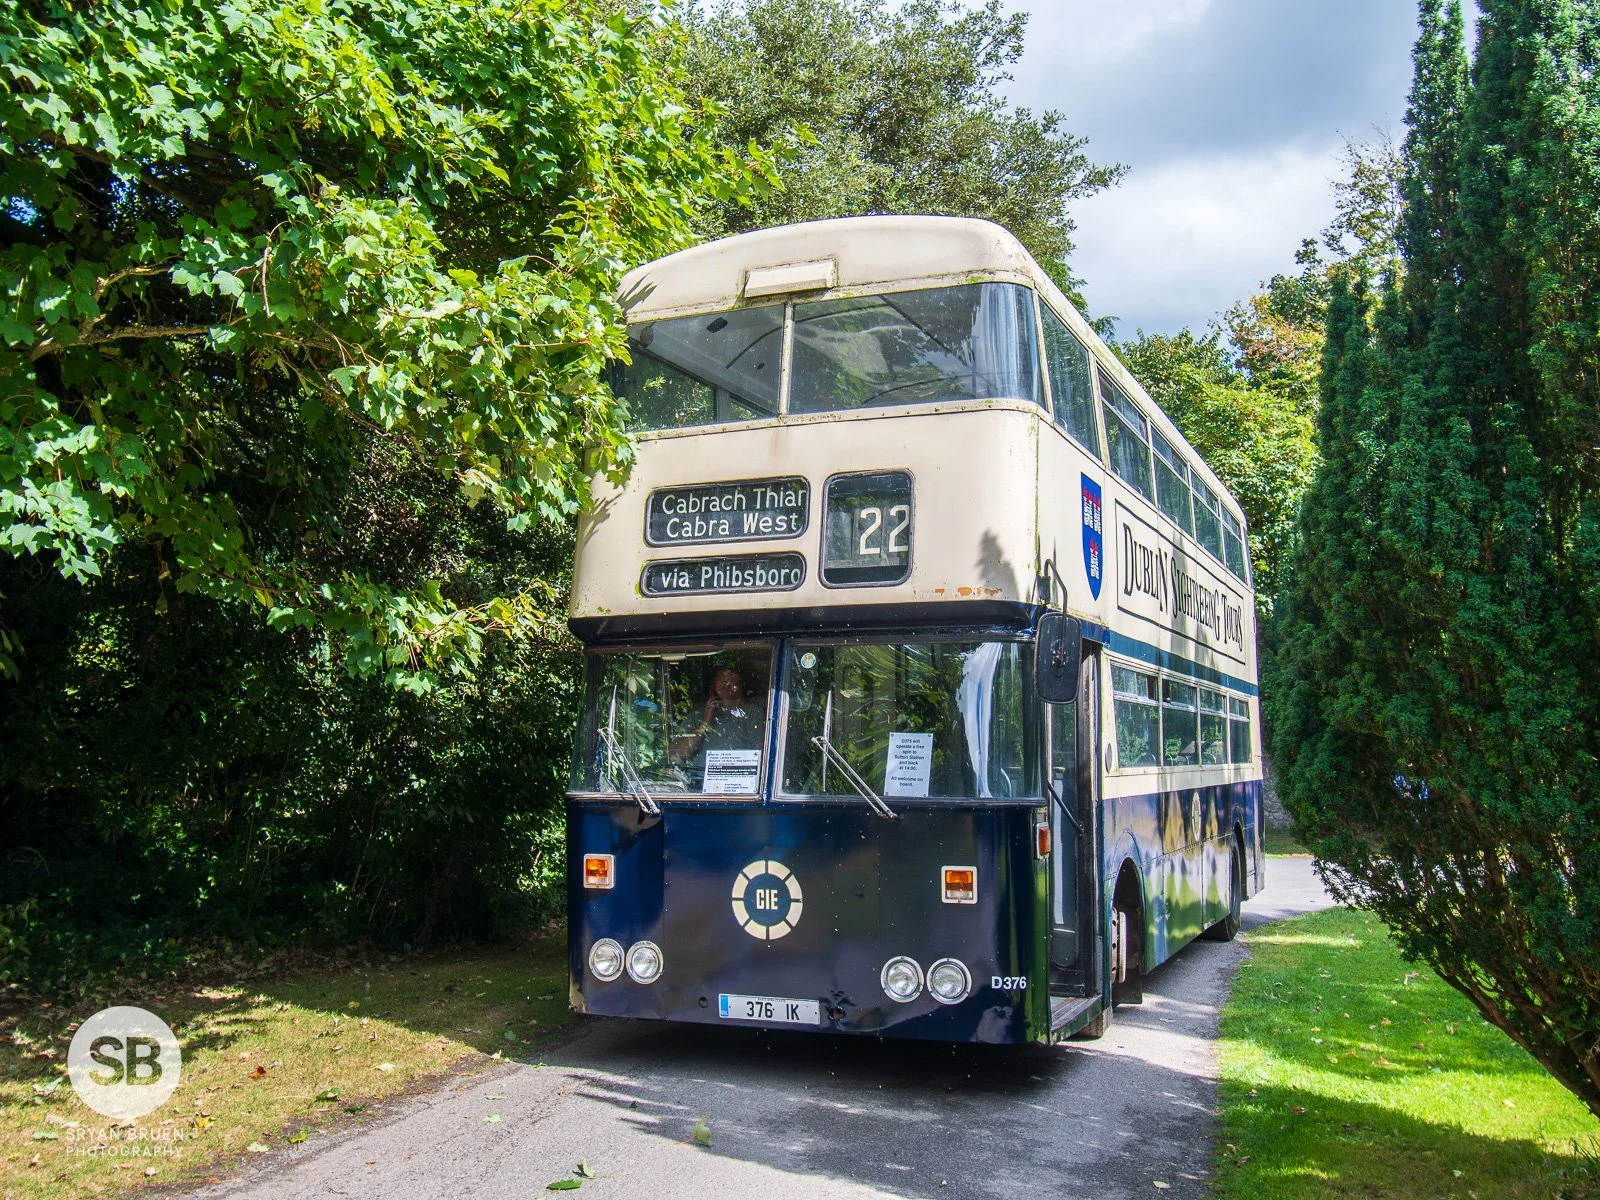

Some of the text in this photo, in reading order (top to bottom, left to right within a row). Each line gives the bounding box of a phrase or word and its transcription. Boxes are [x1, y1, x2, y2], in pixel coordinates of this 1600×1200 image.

[662, 488, 806, 515] Cabrach Thiar
[666, 512, 799, 538] Cabra West
[859, 504, 910, 555] 22
[661, 565, 801, 588] via Phibsboro
[1123, 522, 1243, 652] DUBLIN SIGHTSEEING TOURS
[755, 888, 778, 910] CIE
[991, 976, 1027, 990] D376
[746, 1001, 800, 1020] 376 IK
